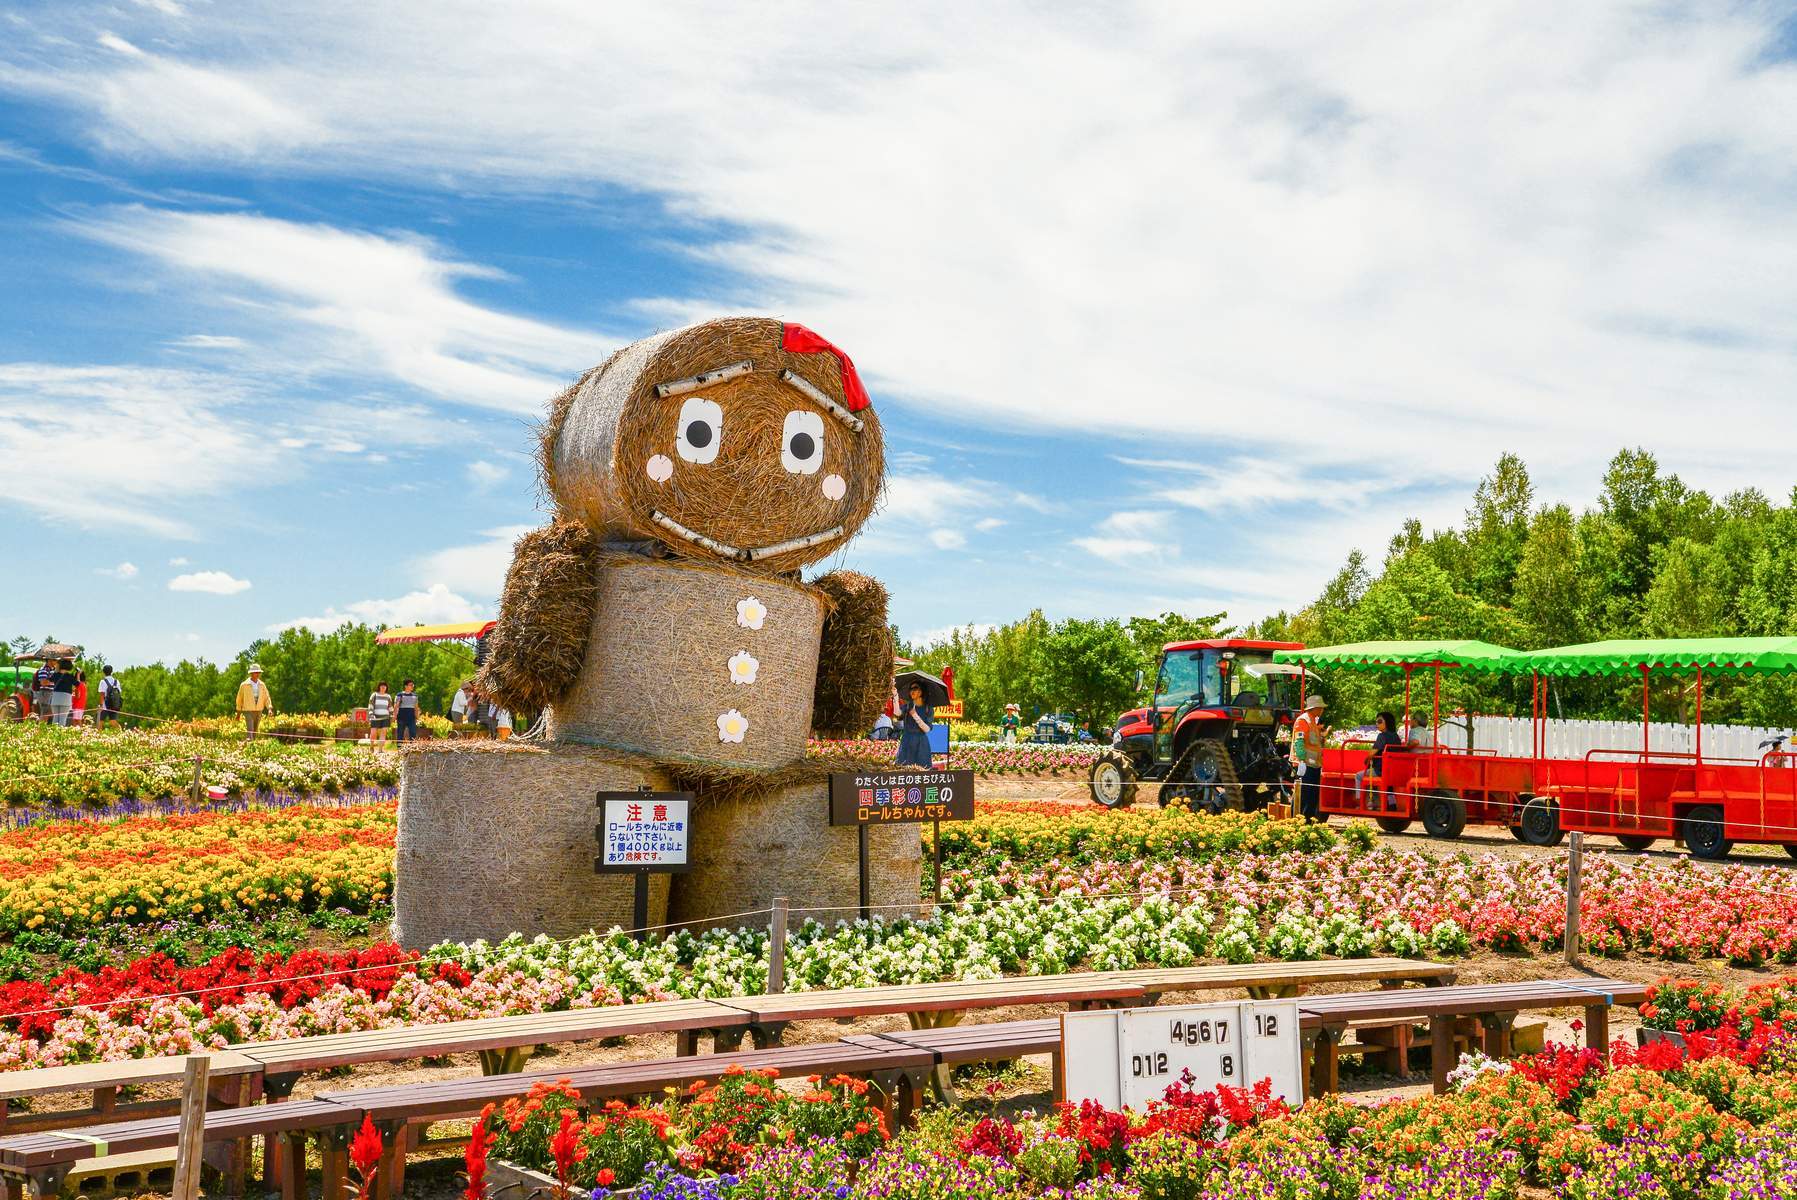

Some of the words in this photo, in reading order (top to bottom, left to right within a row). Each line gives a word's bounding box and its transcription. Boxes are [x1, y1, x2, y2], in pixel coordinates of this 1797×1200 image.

[855, 774, 955, 787] わたくしは丘のまちびえい
[858, 786, 953, 807] 四季彩の丘の
[858, 804, 952, 821] ロールちゃんです。
[609, 822, 684, 832] ロールちゃんに近寄
[609, 832, 673, 842] らないで下さい。
[608, 852, 662, 862] あり危険です。
[1255, 1014, 1278, 1036] 12
[1222, 1053, 1234, 1077] 8
